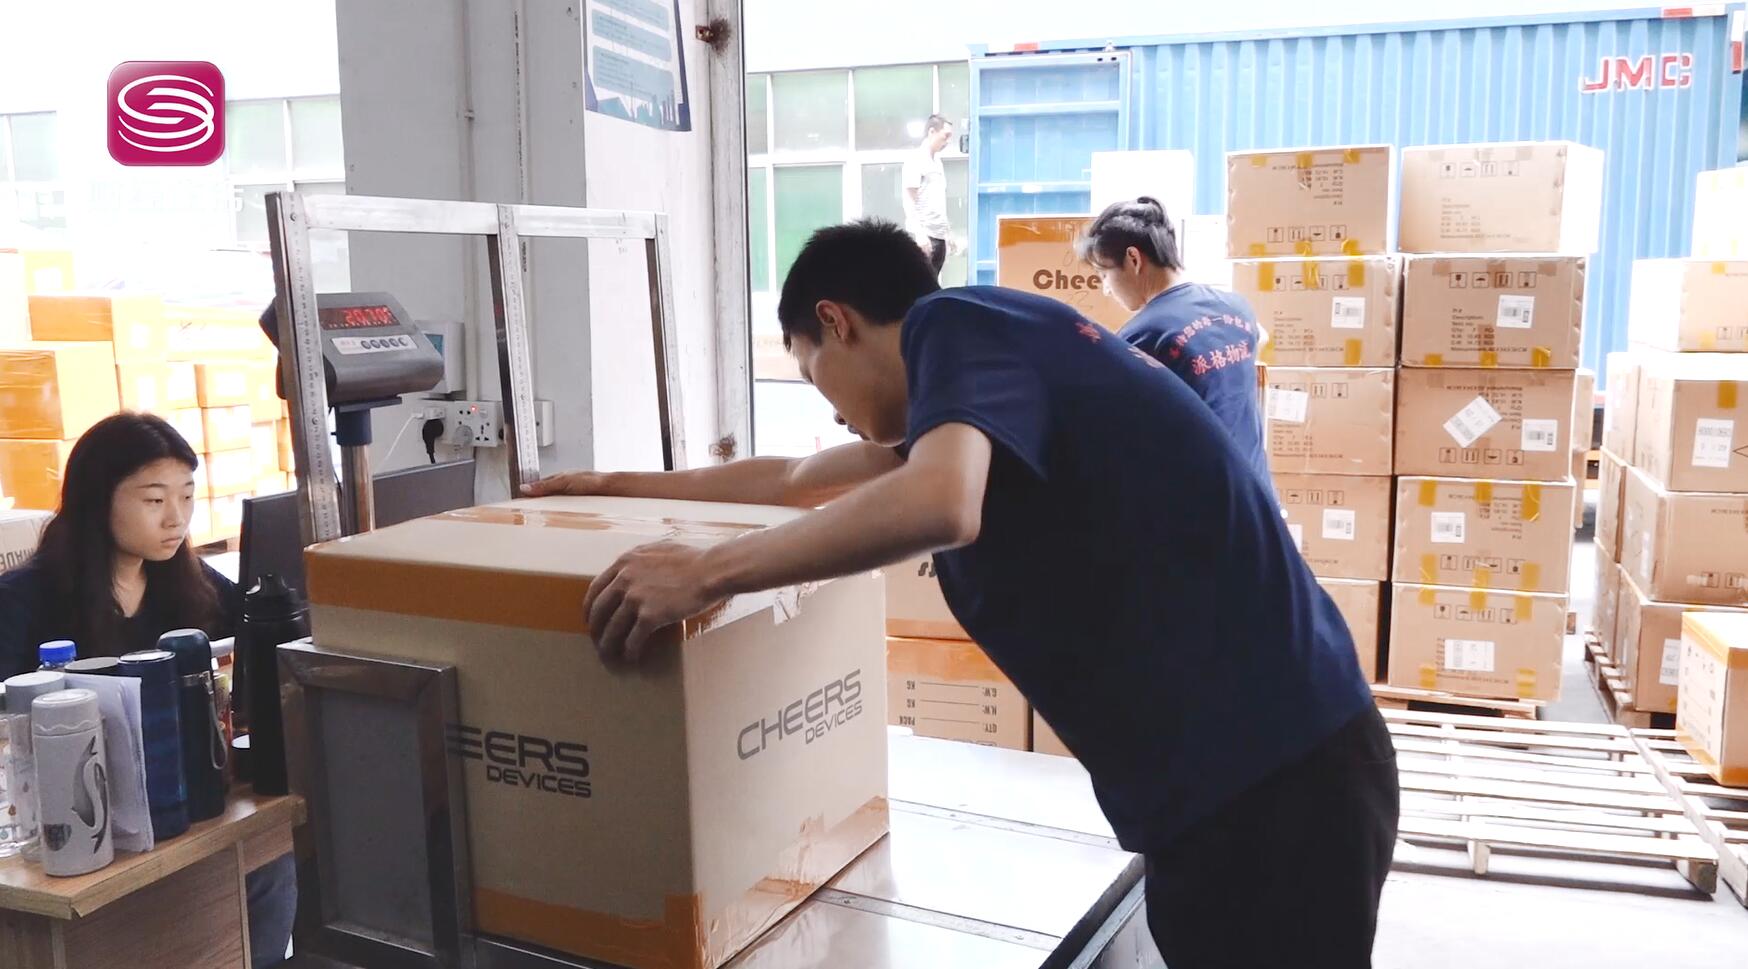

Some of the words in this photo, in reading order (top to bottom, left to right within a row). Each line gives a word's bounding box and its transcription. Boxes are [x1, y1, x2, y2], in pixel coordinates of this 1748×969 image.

[1581, 54, 1691, 91] JMC
[737, 668, 861, 760] CHEERS
[805, 699, 862, 744] DEVICES
[486, 764, 592, 798] DEVICES
